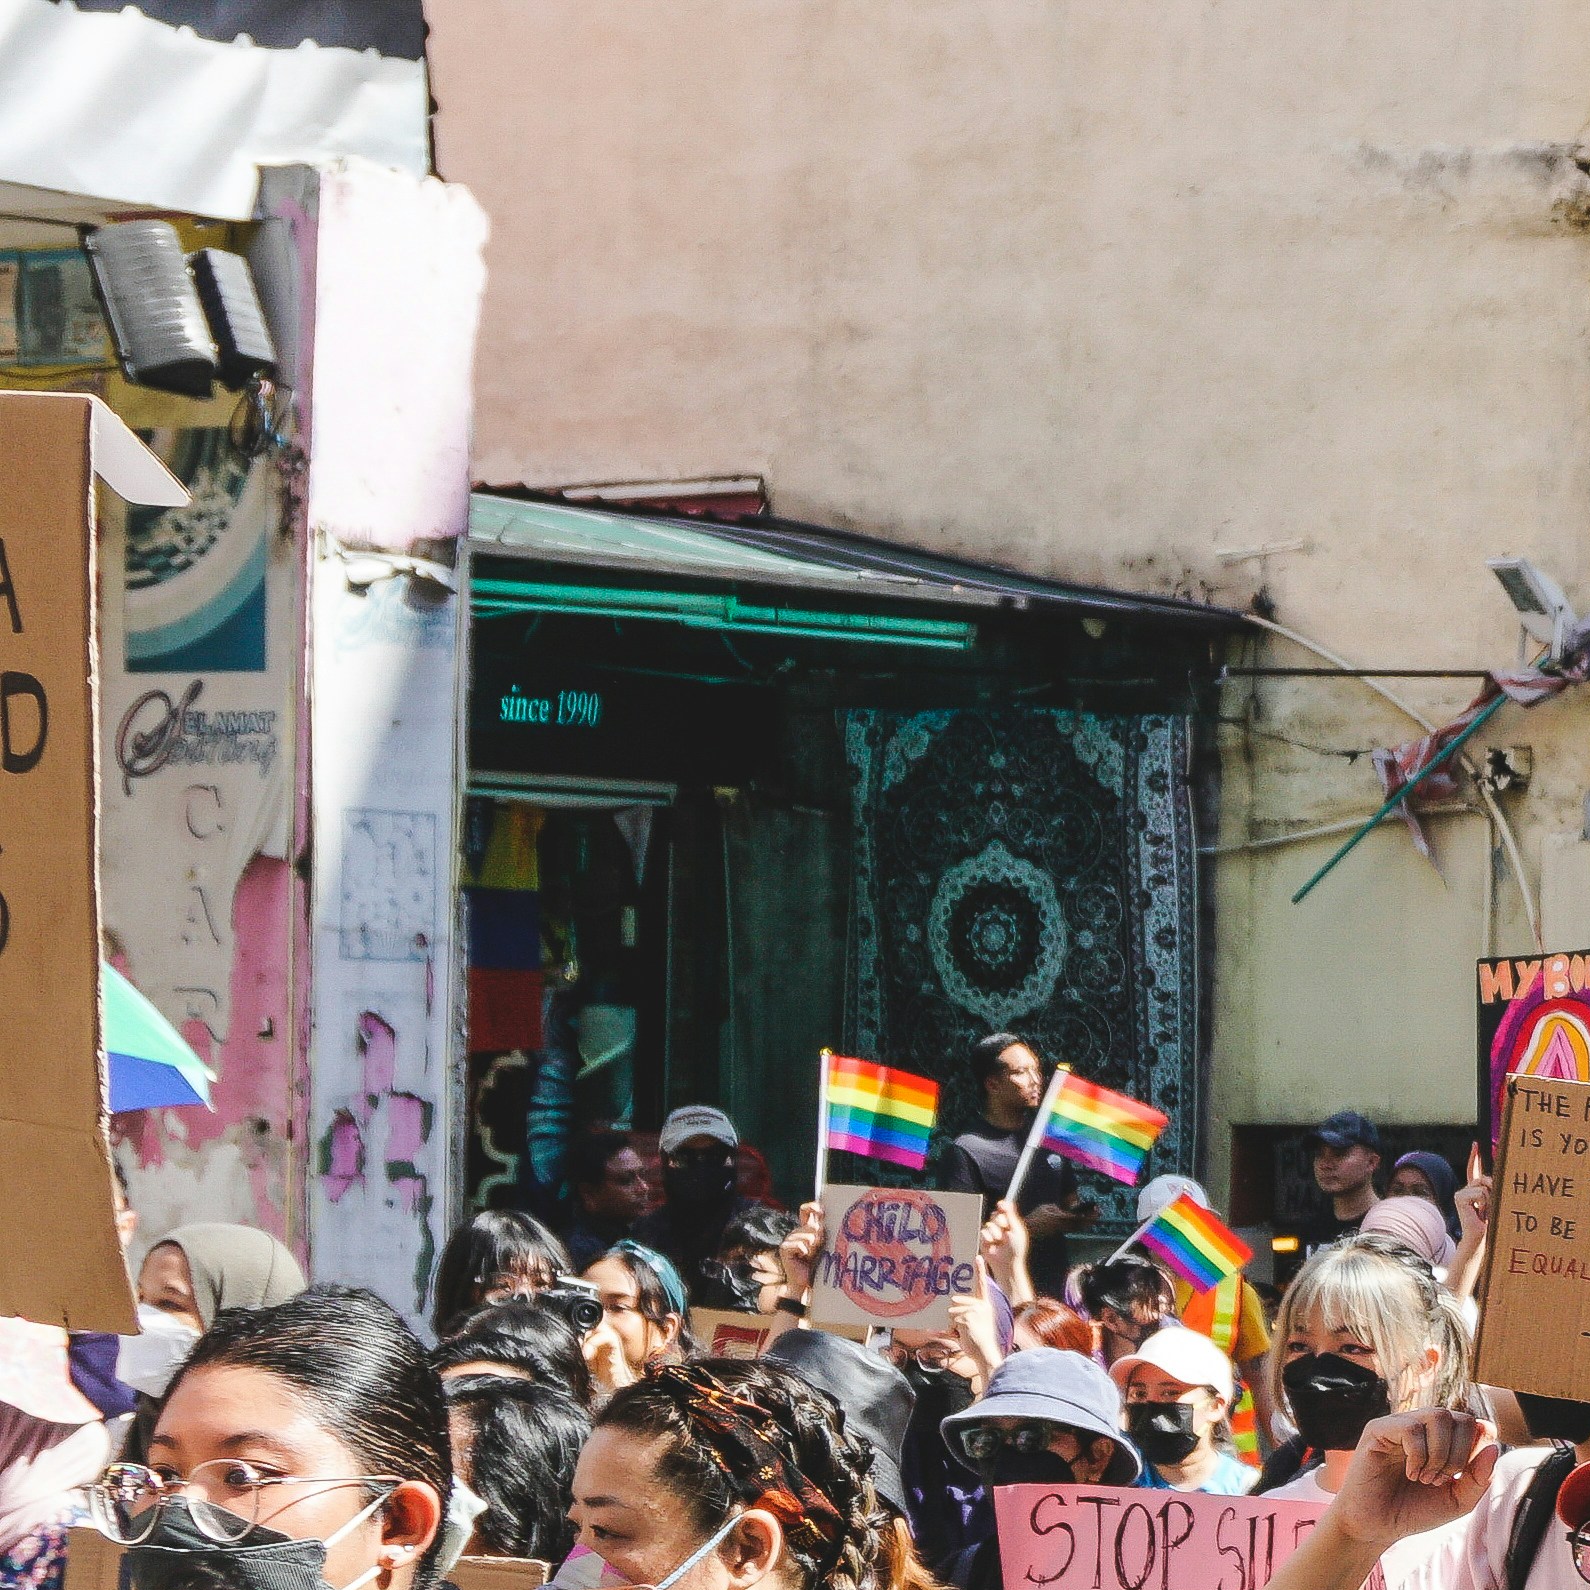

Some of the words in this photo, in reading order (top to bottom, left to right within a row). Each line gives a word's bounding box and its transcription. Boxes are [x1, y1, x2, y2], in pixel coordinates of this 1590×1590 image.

[500, 684, 549, 722] since
[556, 690, 600, 727] 1990
[1478, 956, 1543, 1004] MY
[1519, 1128, 1543, 1148] IS
[1513, 1172, 1575, 1198] HAVE
[1510, 1210, 1538, 1233] TO
[1550, 1216, 1577, 1240] BE
